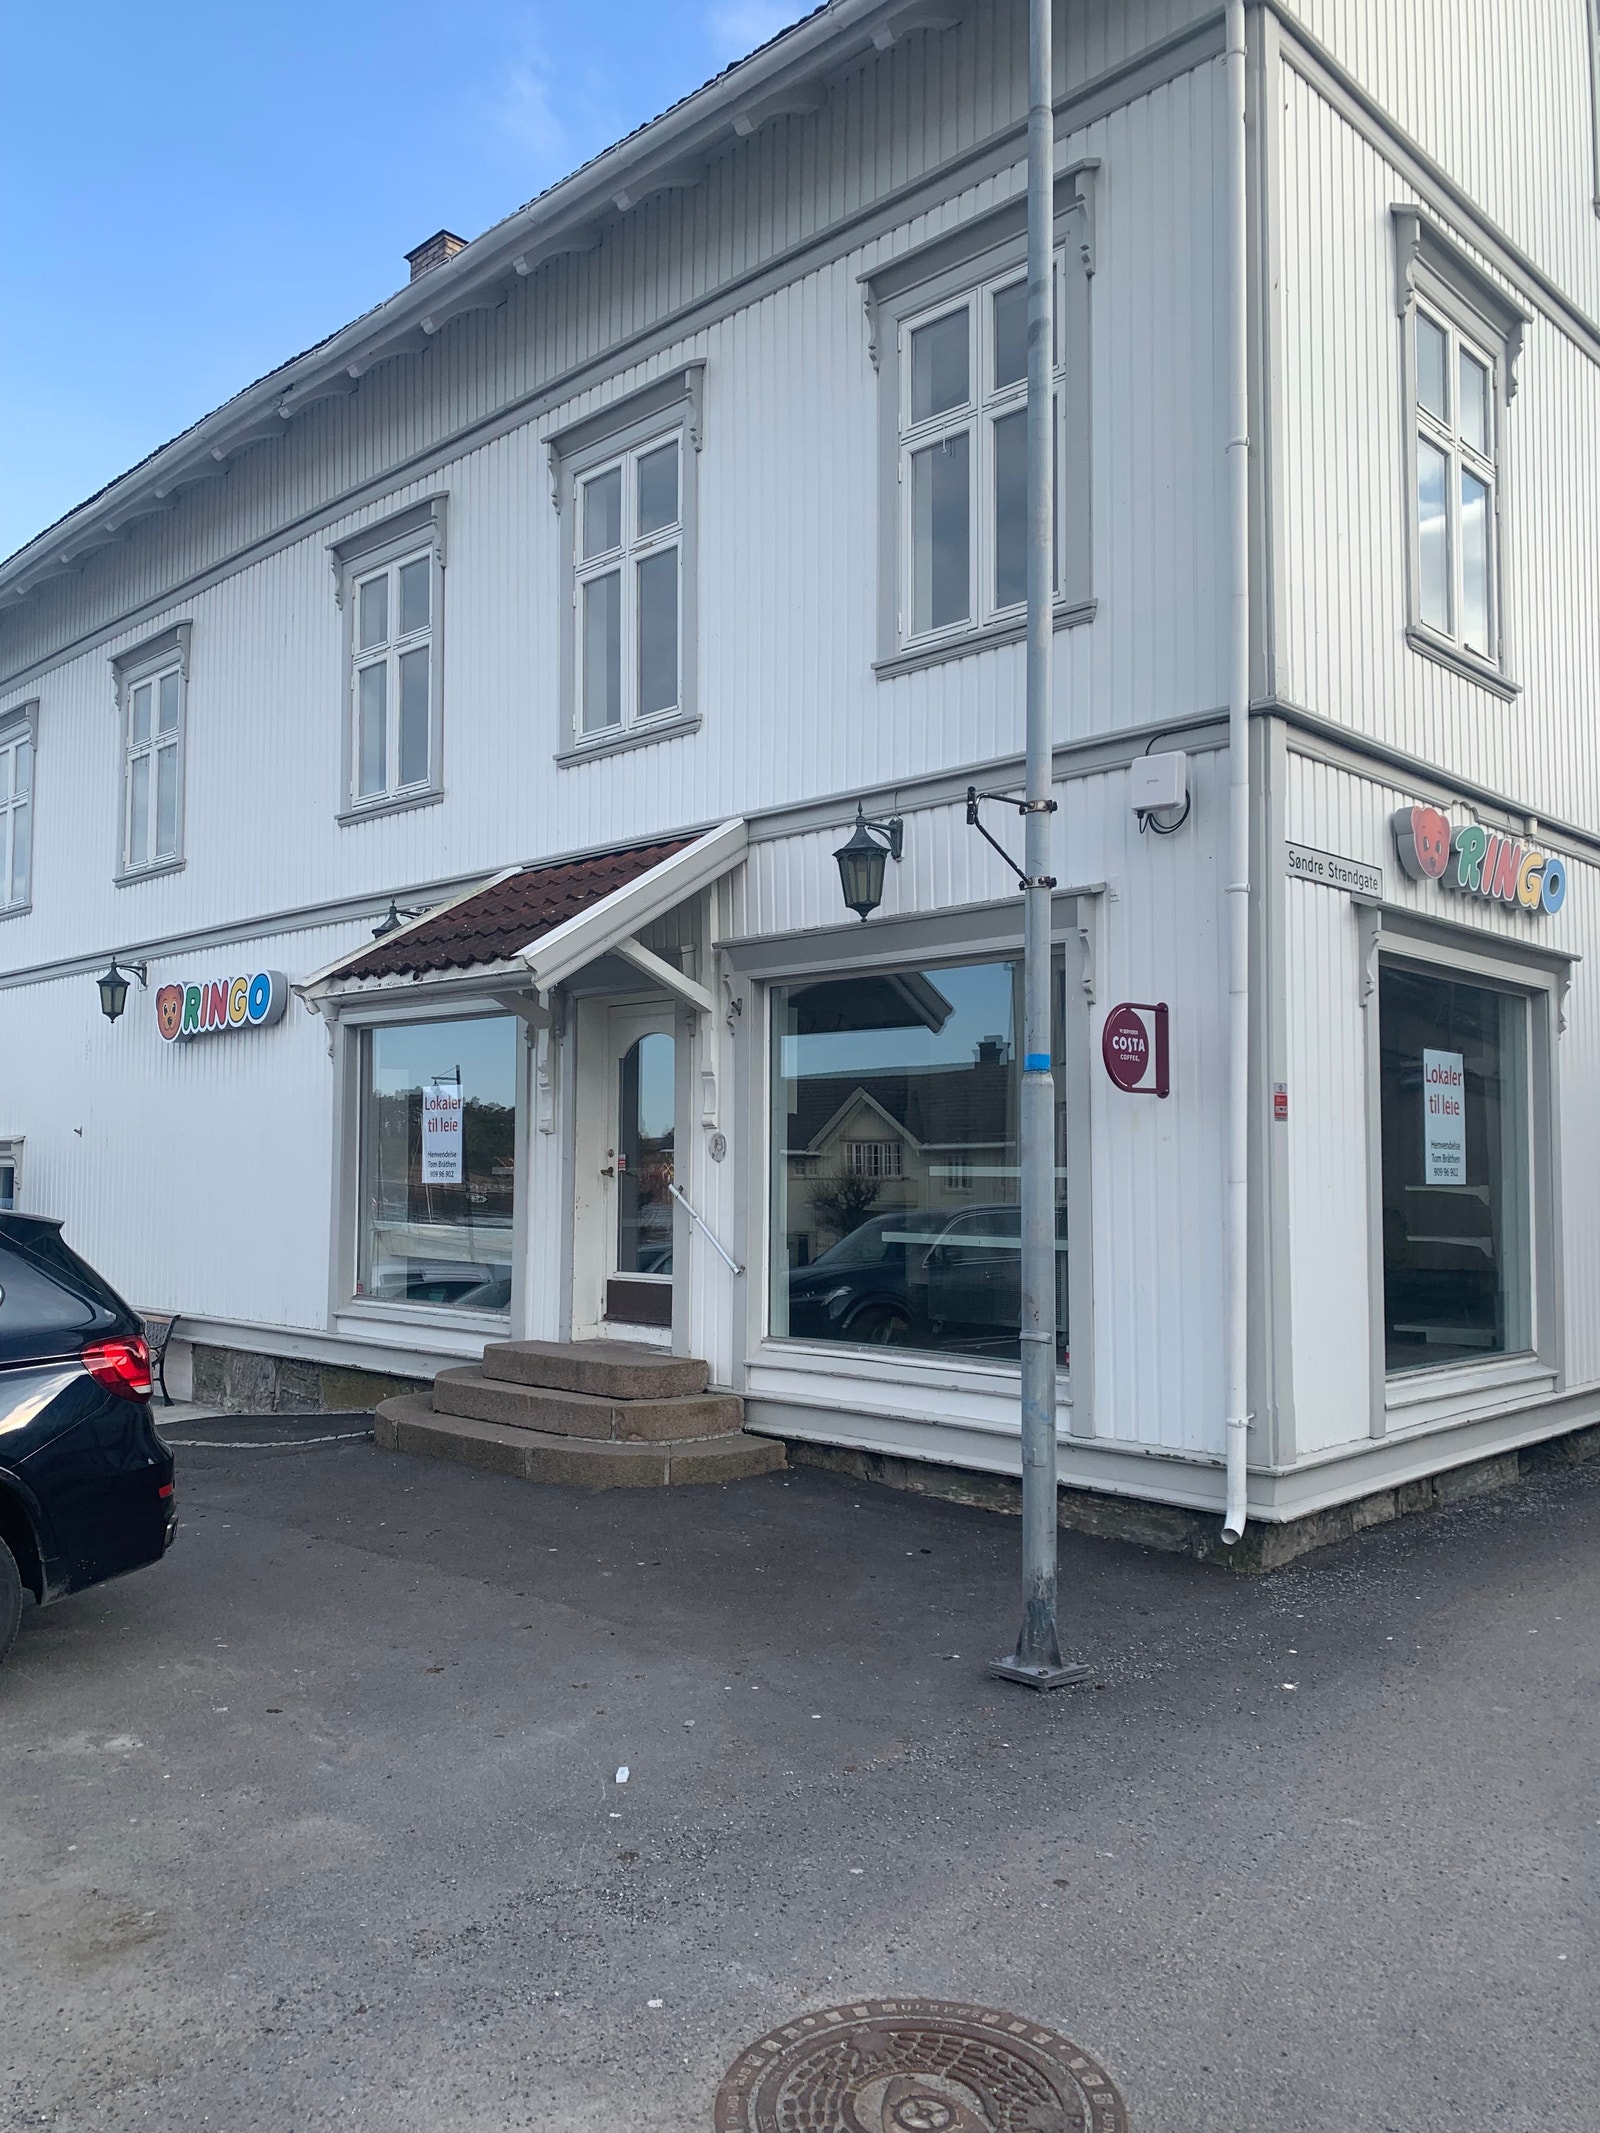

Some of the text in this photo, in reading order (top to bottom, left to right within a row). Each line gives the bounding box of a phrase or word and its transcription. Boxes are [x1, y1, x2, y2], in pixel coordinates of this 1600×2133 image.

[1288, 850, 1378, 890] Søndre Strandgate
[1456, 825, 1567, 915] RINGO
[183, 972, 271, 1031] RINGO
[1112, 1035, 1146, 1053] COSTA
[1425, 1063, 1462, 1086] Lokaler
[424, 1095, 462, 1111] Lokaler
[1429, 1093, 1460, 1116] til leie
[427, 1116, 458, 1133] til leie
[1431, 1153, 1442, 1163] Tom
